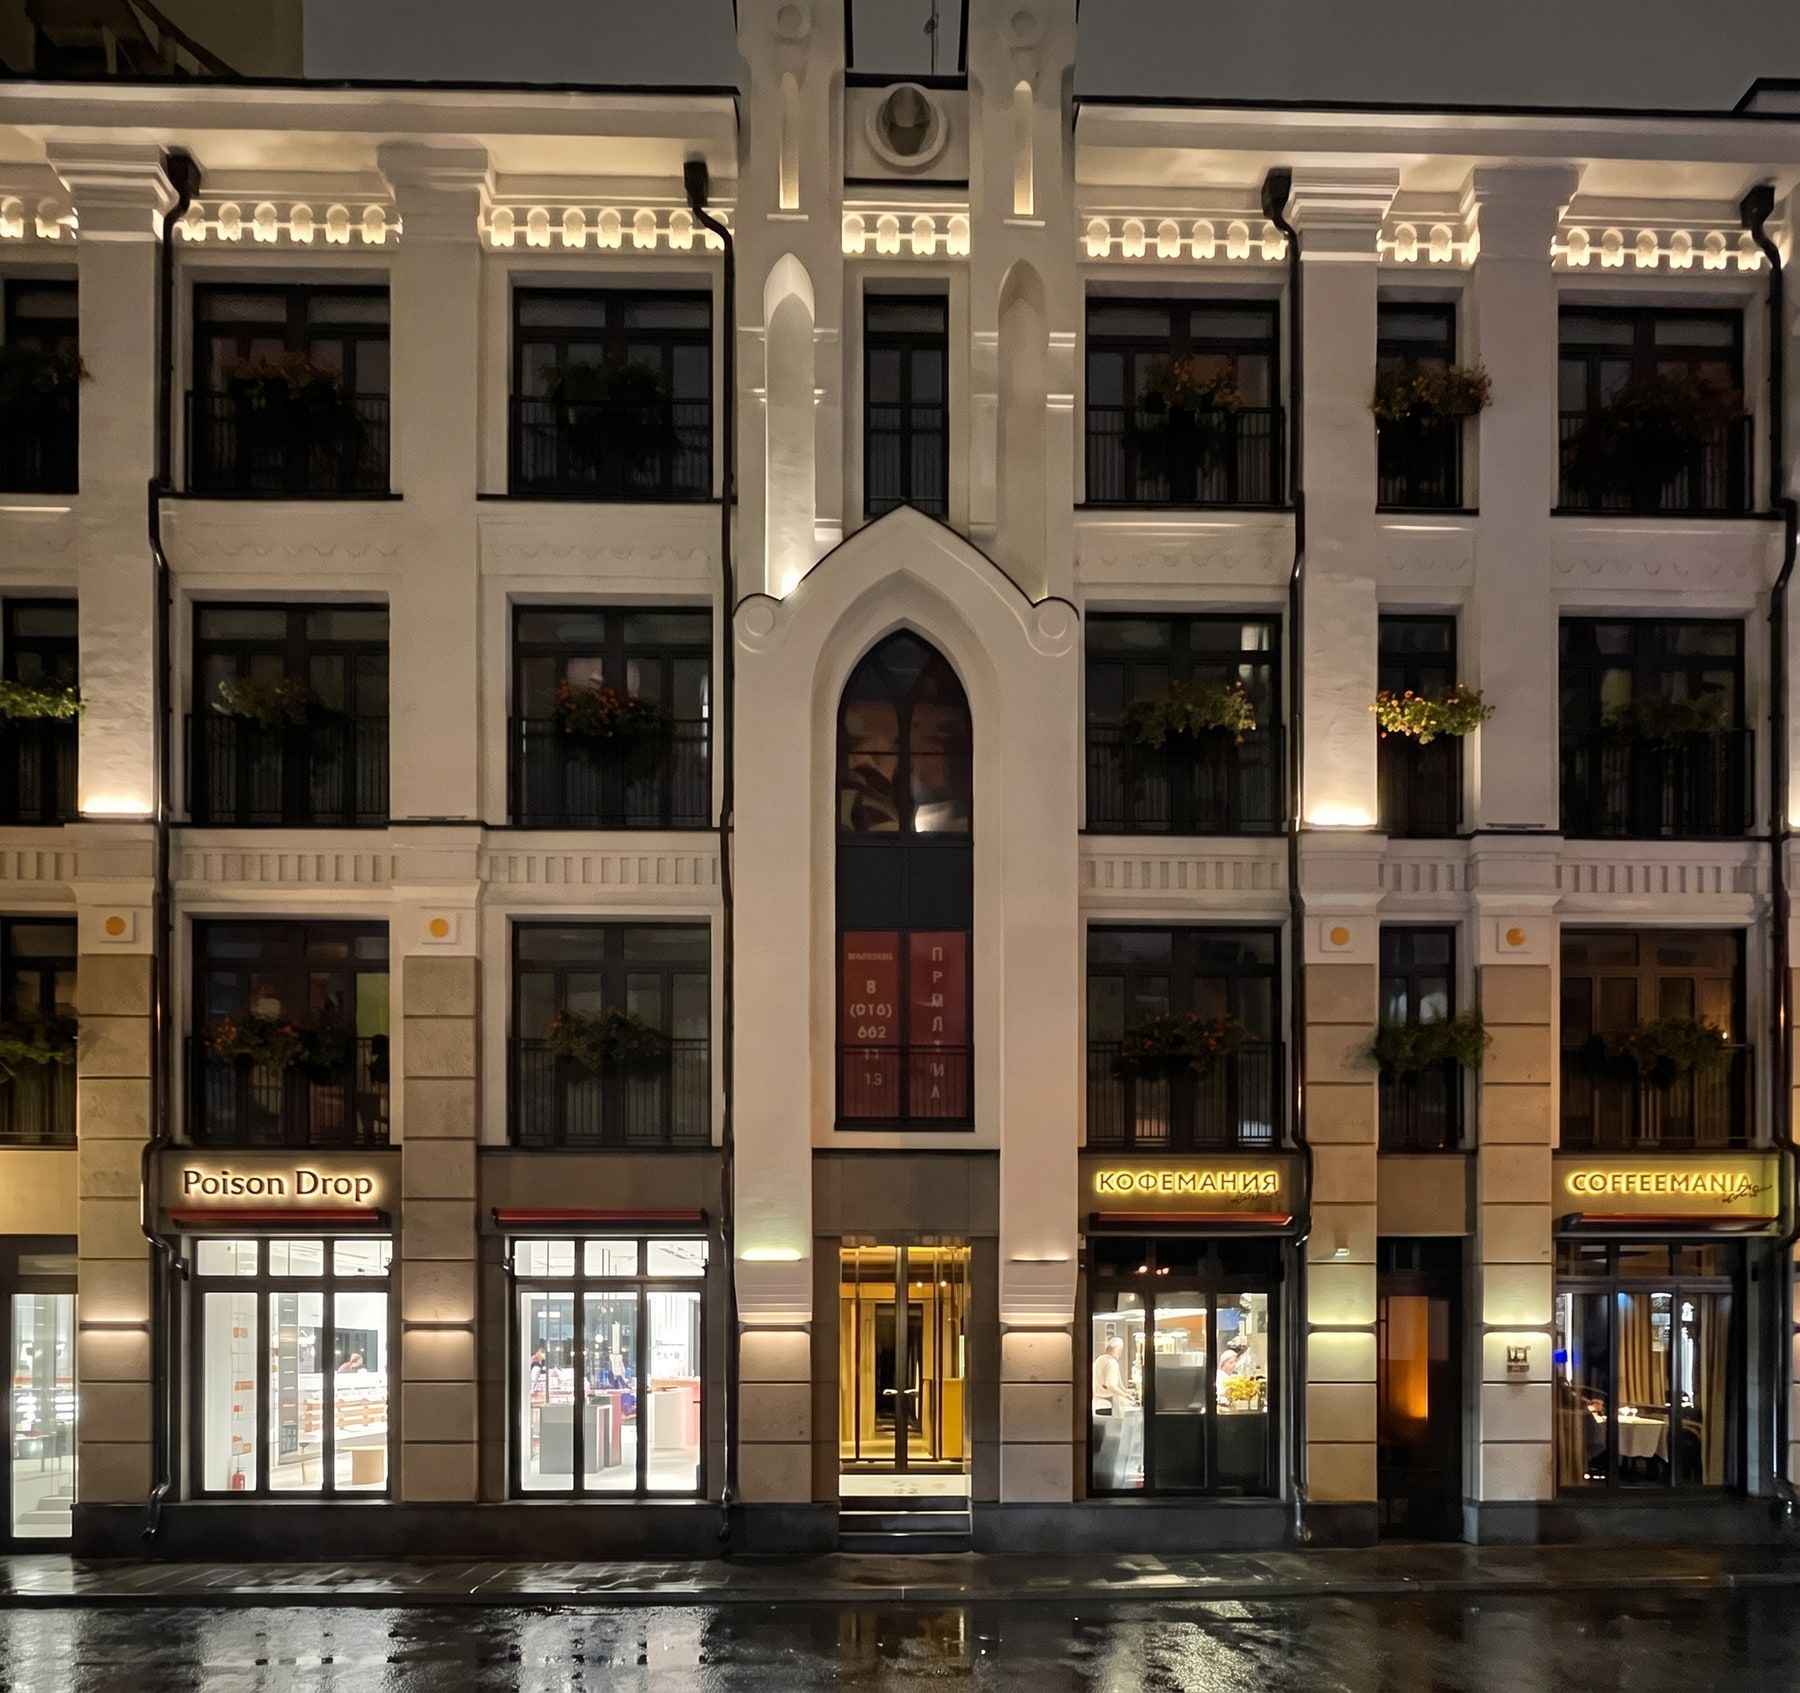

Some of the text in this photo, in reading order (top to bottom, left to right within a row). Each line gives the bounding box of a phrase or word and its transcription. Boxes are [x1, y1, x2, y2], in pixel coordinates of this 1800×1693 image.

[857, 1025, 887, 1039] 662
[182, 1169, 374, 1203] Poison Drop
[1099, 1172, 1277, 1191] КОФЕМАНИЯ
[1573, 1173, 1752, 1192] COFFEEMANIA
